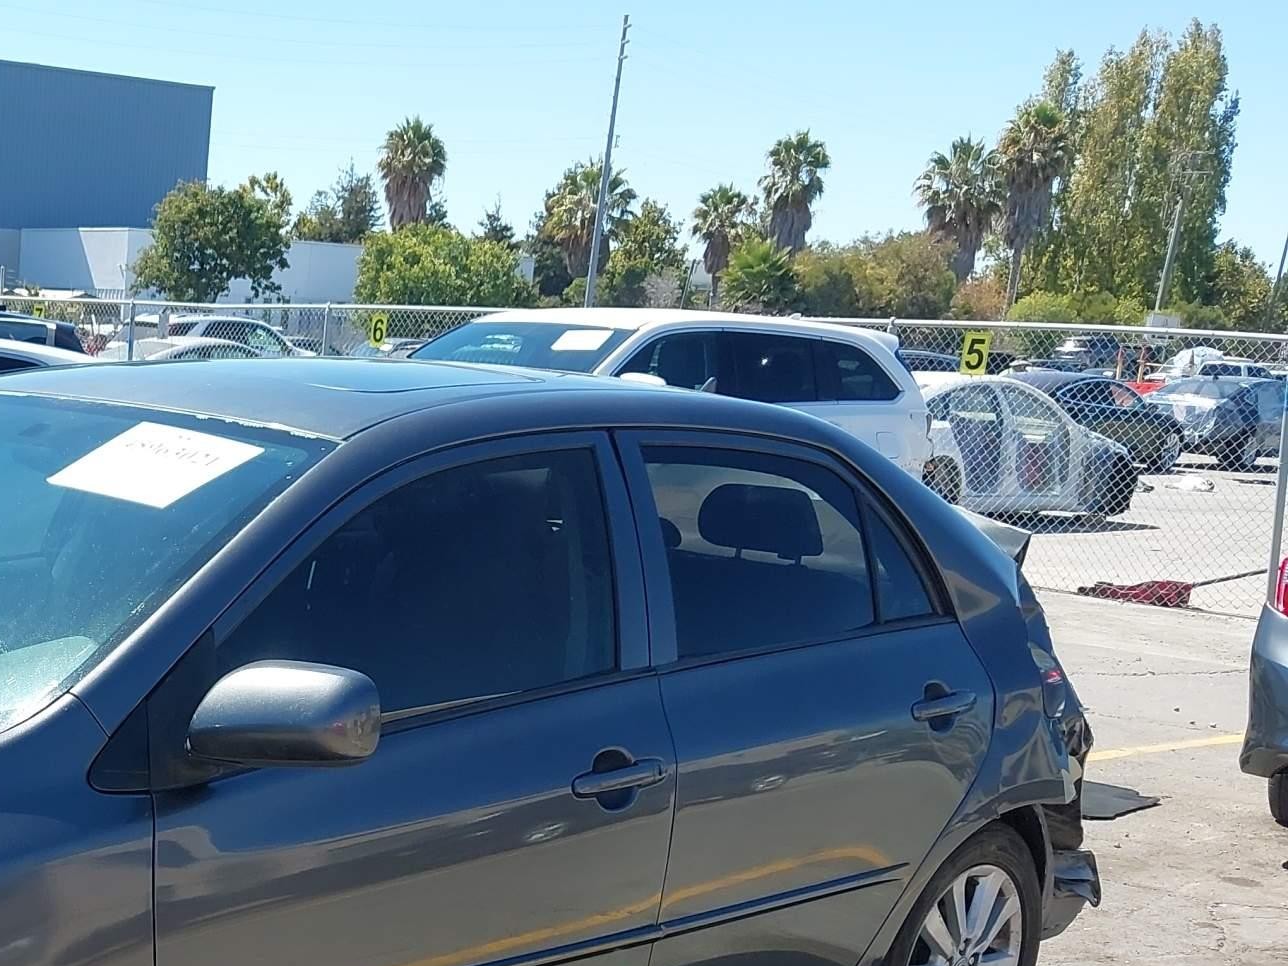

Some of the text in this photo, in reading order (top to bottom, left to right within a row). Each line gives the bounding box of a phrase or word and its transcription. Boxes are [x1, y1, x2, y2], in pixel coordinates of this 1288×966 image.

[35, 307, 43, 318] 7
[373, 318, 383, 342] 6
[964, 338, 986, 370] 5
